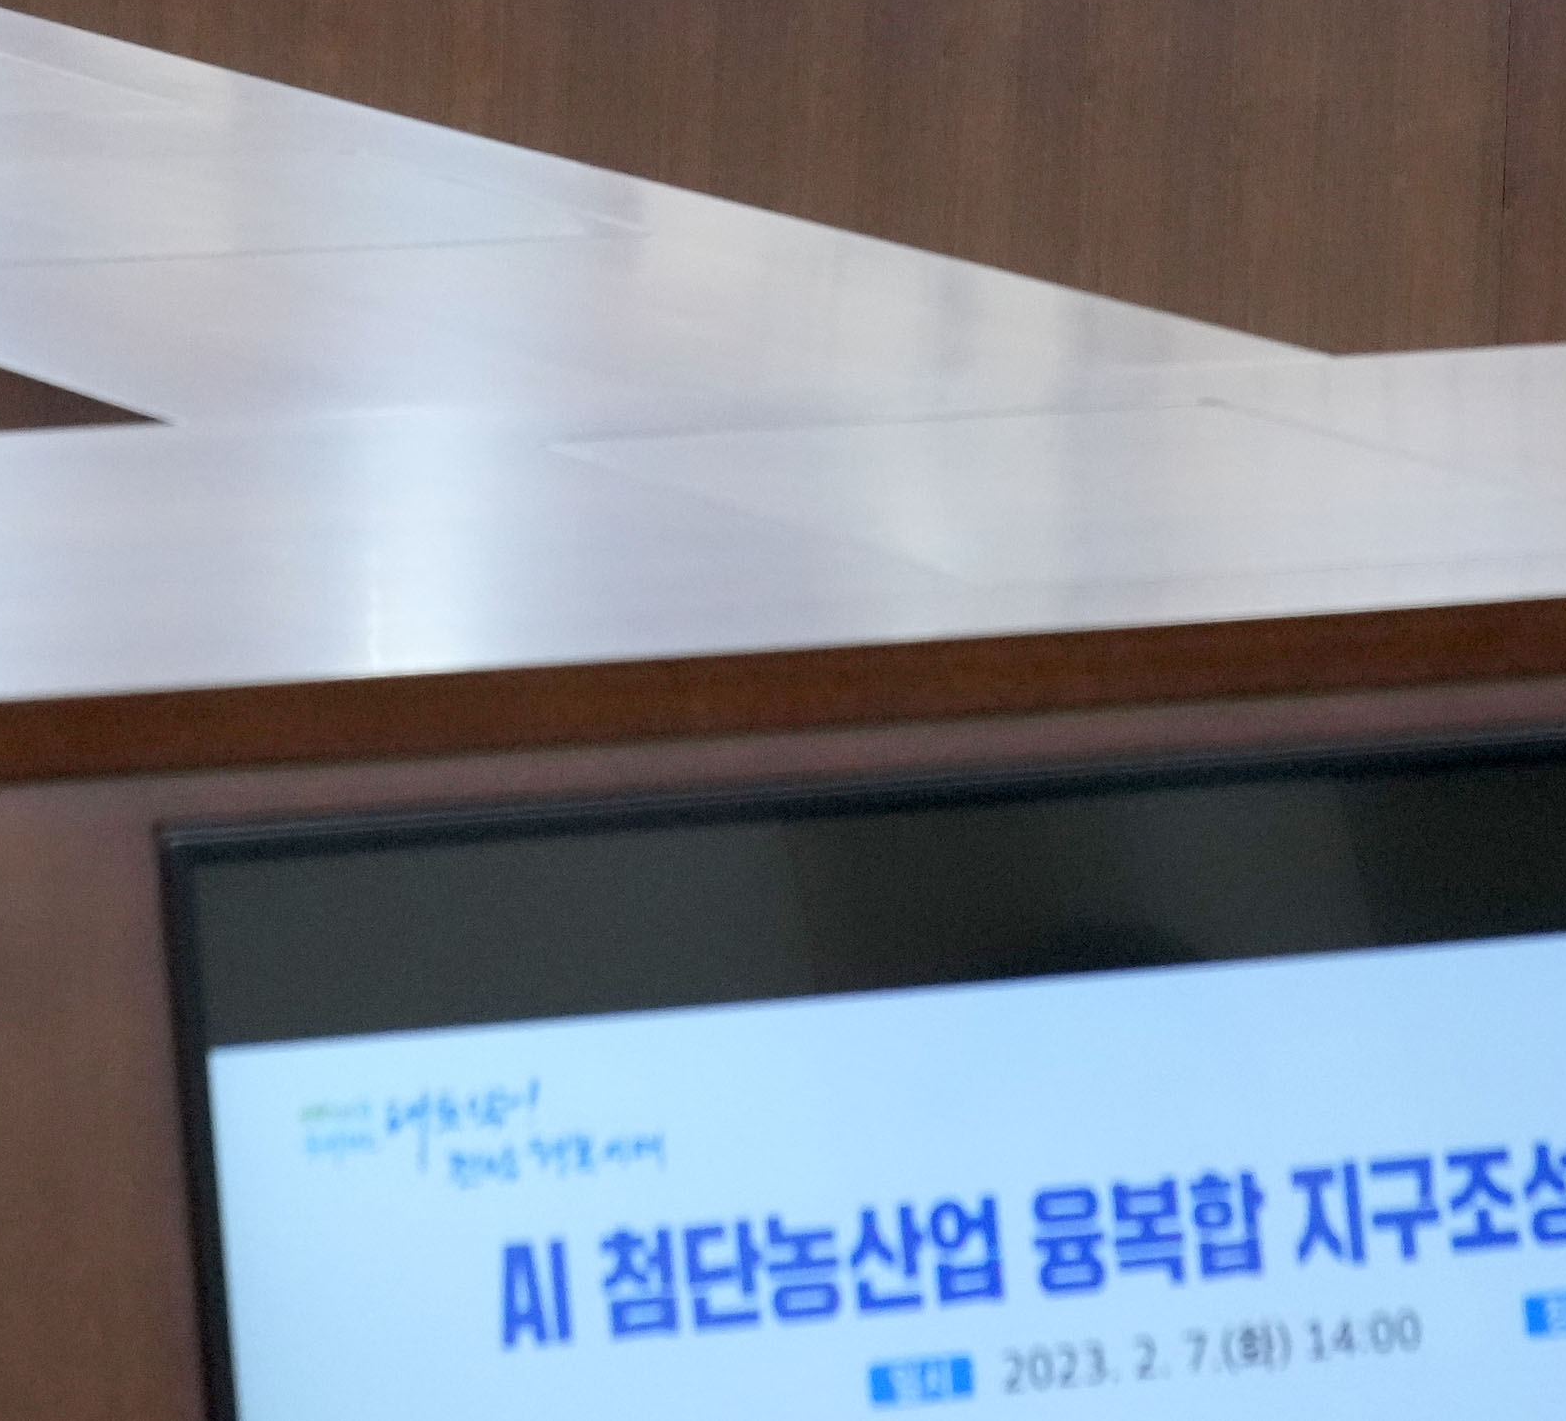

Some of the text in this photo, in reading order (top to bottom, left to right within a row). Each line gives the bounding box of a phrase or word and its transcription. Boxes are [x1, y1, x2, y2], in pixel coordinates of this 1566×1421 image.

[501, 1239, 572, 1349] AI
[600, 1193, 1008, 1339] 첨단농산업
[1031, 1168, 1266, 1297] 융복합
